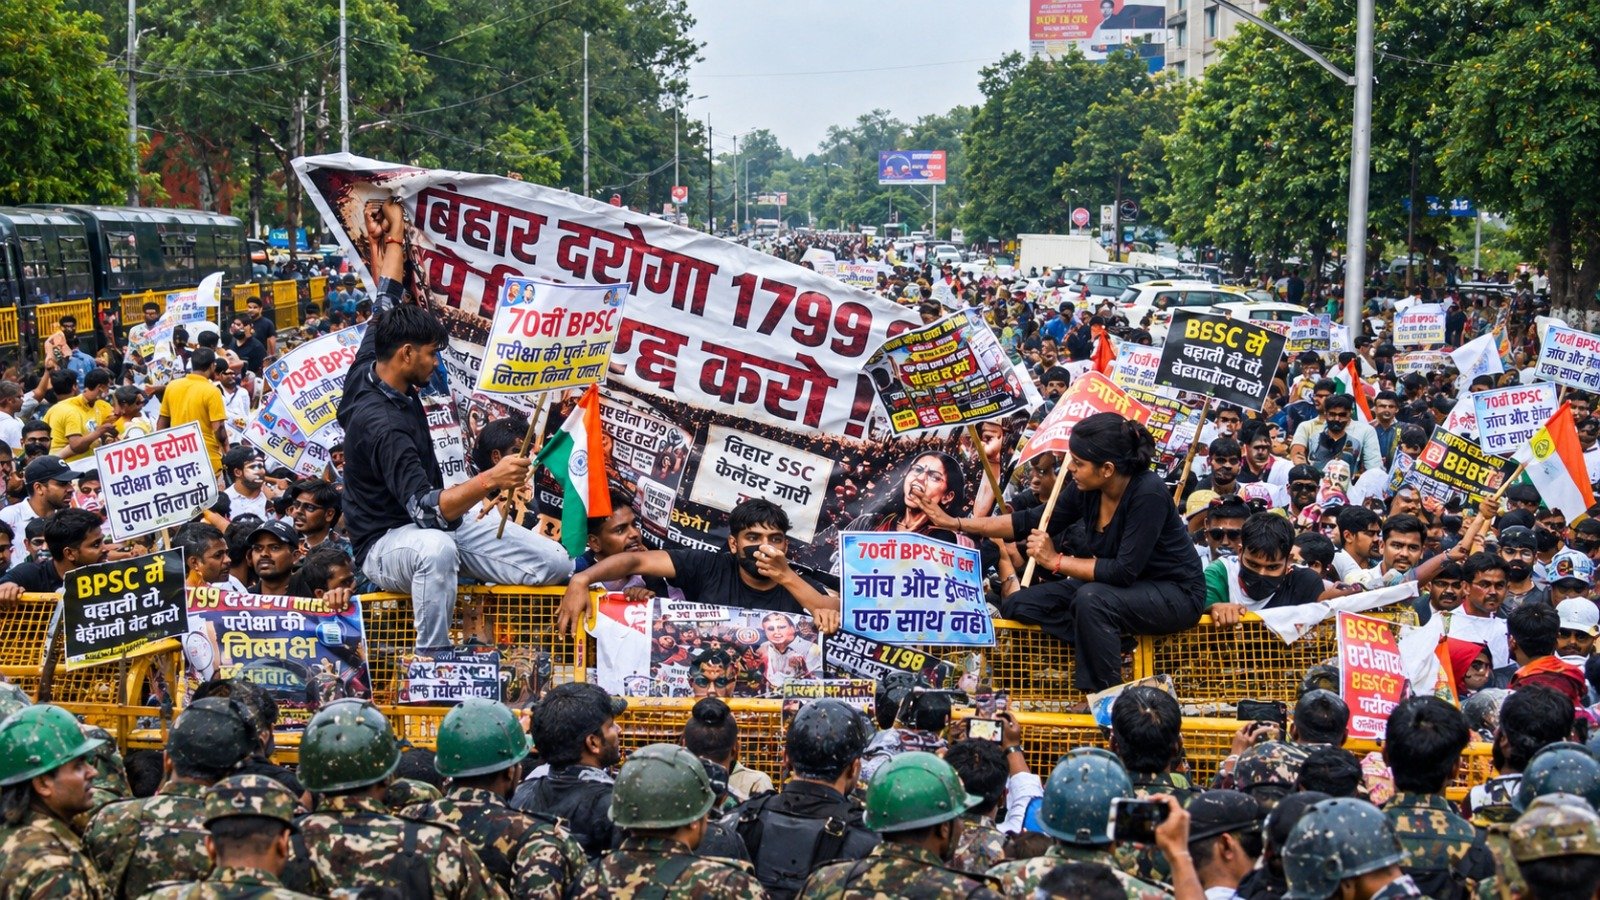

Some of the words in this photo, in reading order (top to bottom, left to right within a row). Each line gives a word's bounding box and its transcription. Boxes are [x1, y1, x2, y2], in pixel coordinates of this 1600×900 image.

[414, 184, 548, 265] बिहार
[556, 222, 719, 318] दरोगा
[731, 273, 873, 358] 1799
[508, 306, 566, 338] 70वीं
[566, 308, 617, 337] BPSC
[543, 342, 562, 363] की
[700, 341, 837, 429] करो
[1511, 389, 1543, 406] BPSC
[104, 443, 150, 475] 1799
[151, 433, 199, 462] दरोगा
[725, 434, 774, 466] बिहार
[776, 457, 816, 482] SSC
[110, 475, 152, 498] परीक्षा
[152, 465, 173, 487] की
[716, 458, 771, 493] केलेंडर
[774, 479, 812, 506] जारी
[858, 539, 898, 561] 70वीं
[900, 543, 939, 563] BPSC
[76, 567, 140, 599] BPSC
[144, 555, 166, 584] में
[852, 569, 895, 598] जांच
[901, 568, 941, 599] और
[186, 586, 221, 609] 799
[221, 611, 277, 632] परीक्षा
[279, 611, 306, 631] की
[852, 609, 891, 632] एक
[895, 609, 946, 633] साथ
[950, 608, 987, 635] नहीं
[1345, 618, 1389, 645] BSSC
